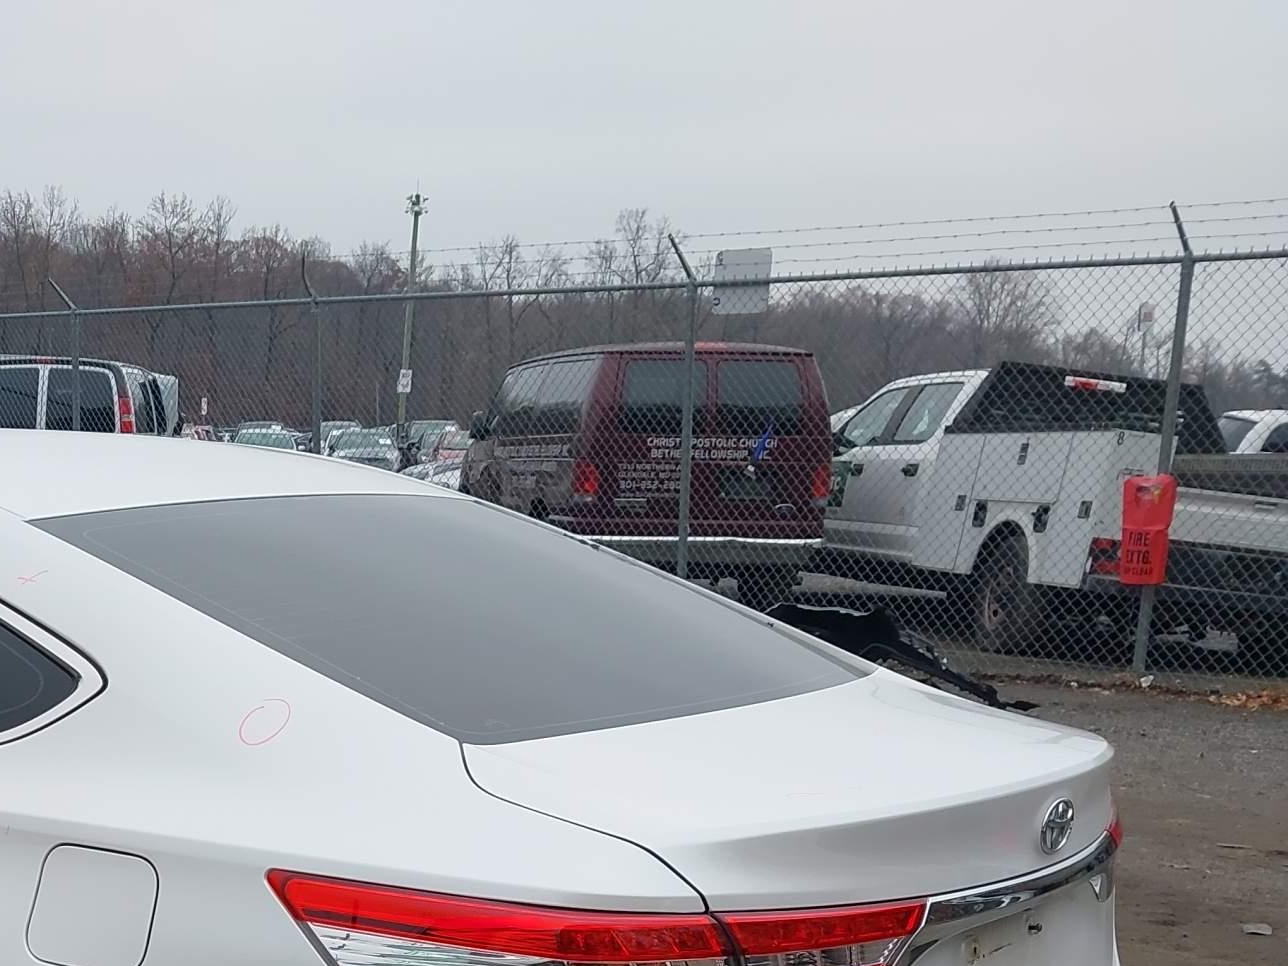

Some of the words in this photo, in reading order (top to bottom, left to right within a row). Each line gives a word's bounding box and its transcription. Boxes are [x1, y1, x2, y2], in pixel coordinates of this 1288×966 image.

[647, 437, 681, 448] CHRIST
[691, 438, 737, 448] POSTOLIC
[1117, 431, 1125, 446] 8
[651, 449, 682, 458] BETHE
[1128, 532, 1151, 547] FIRE
